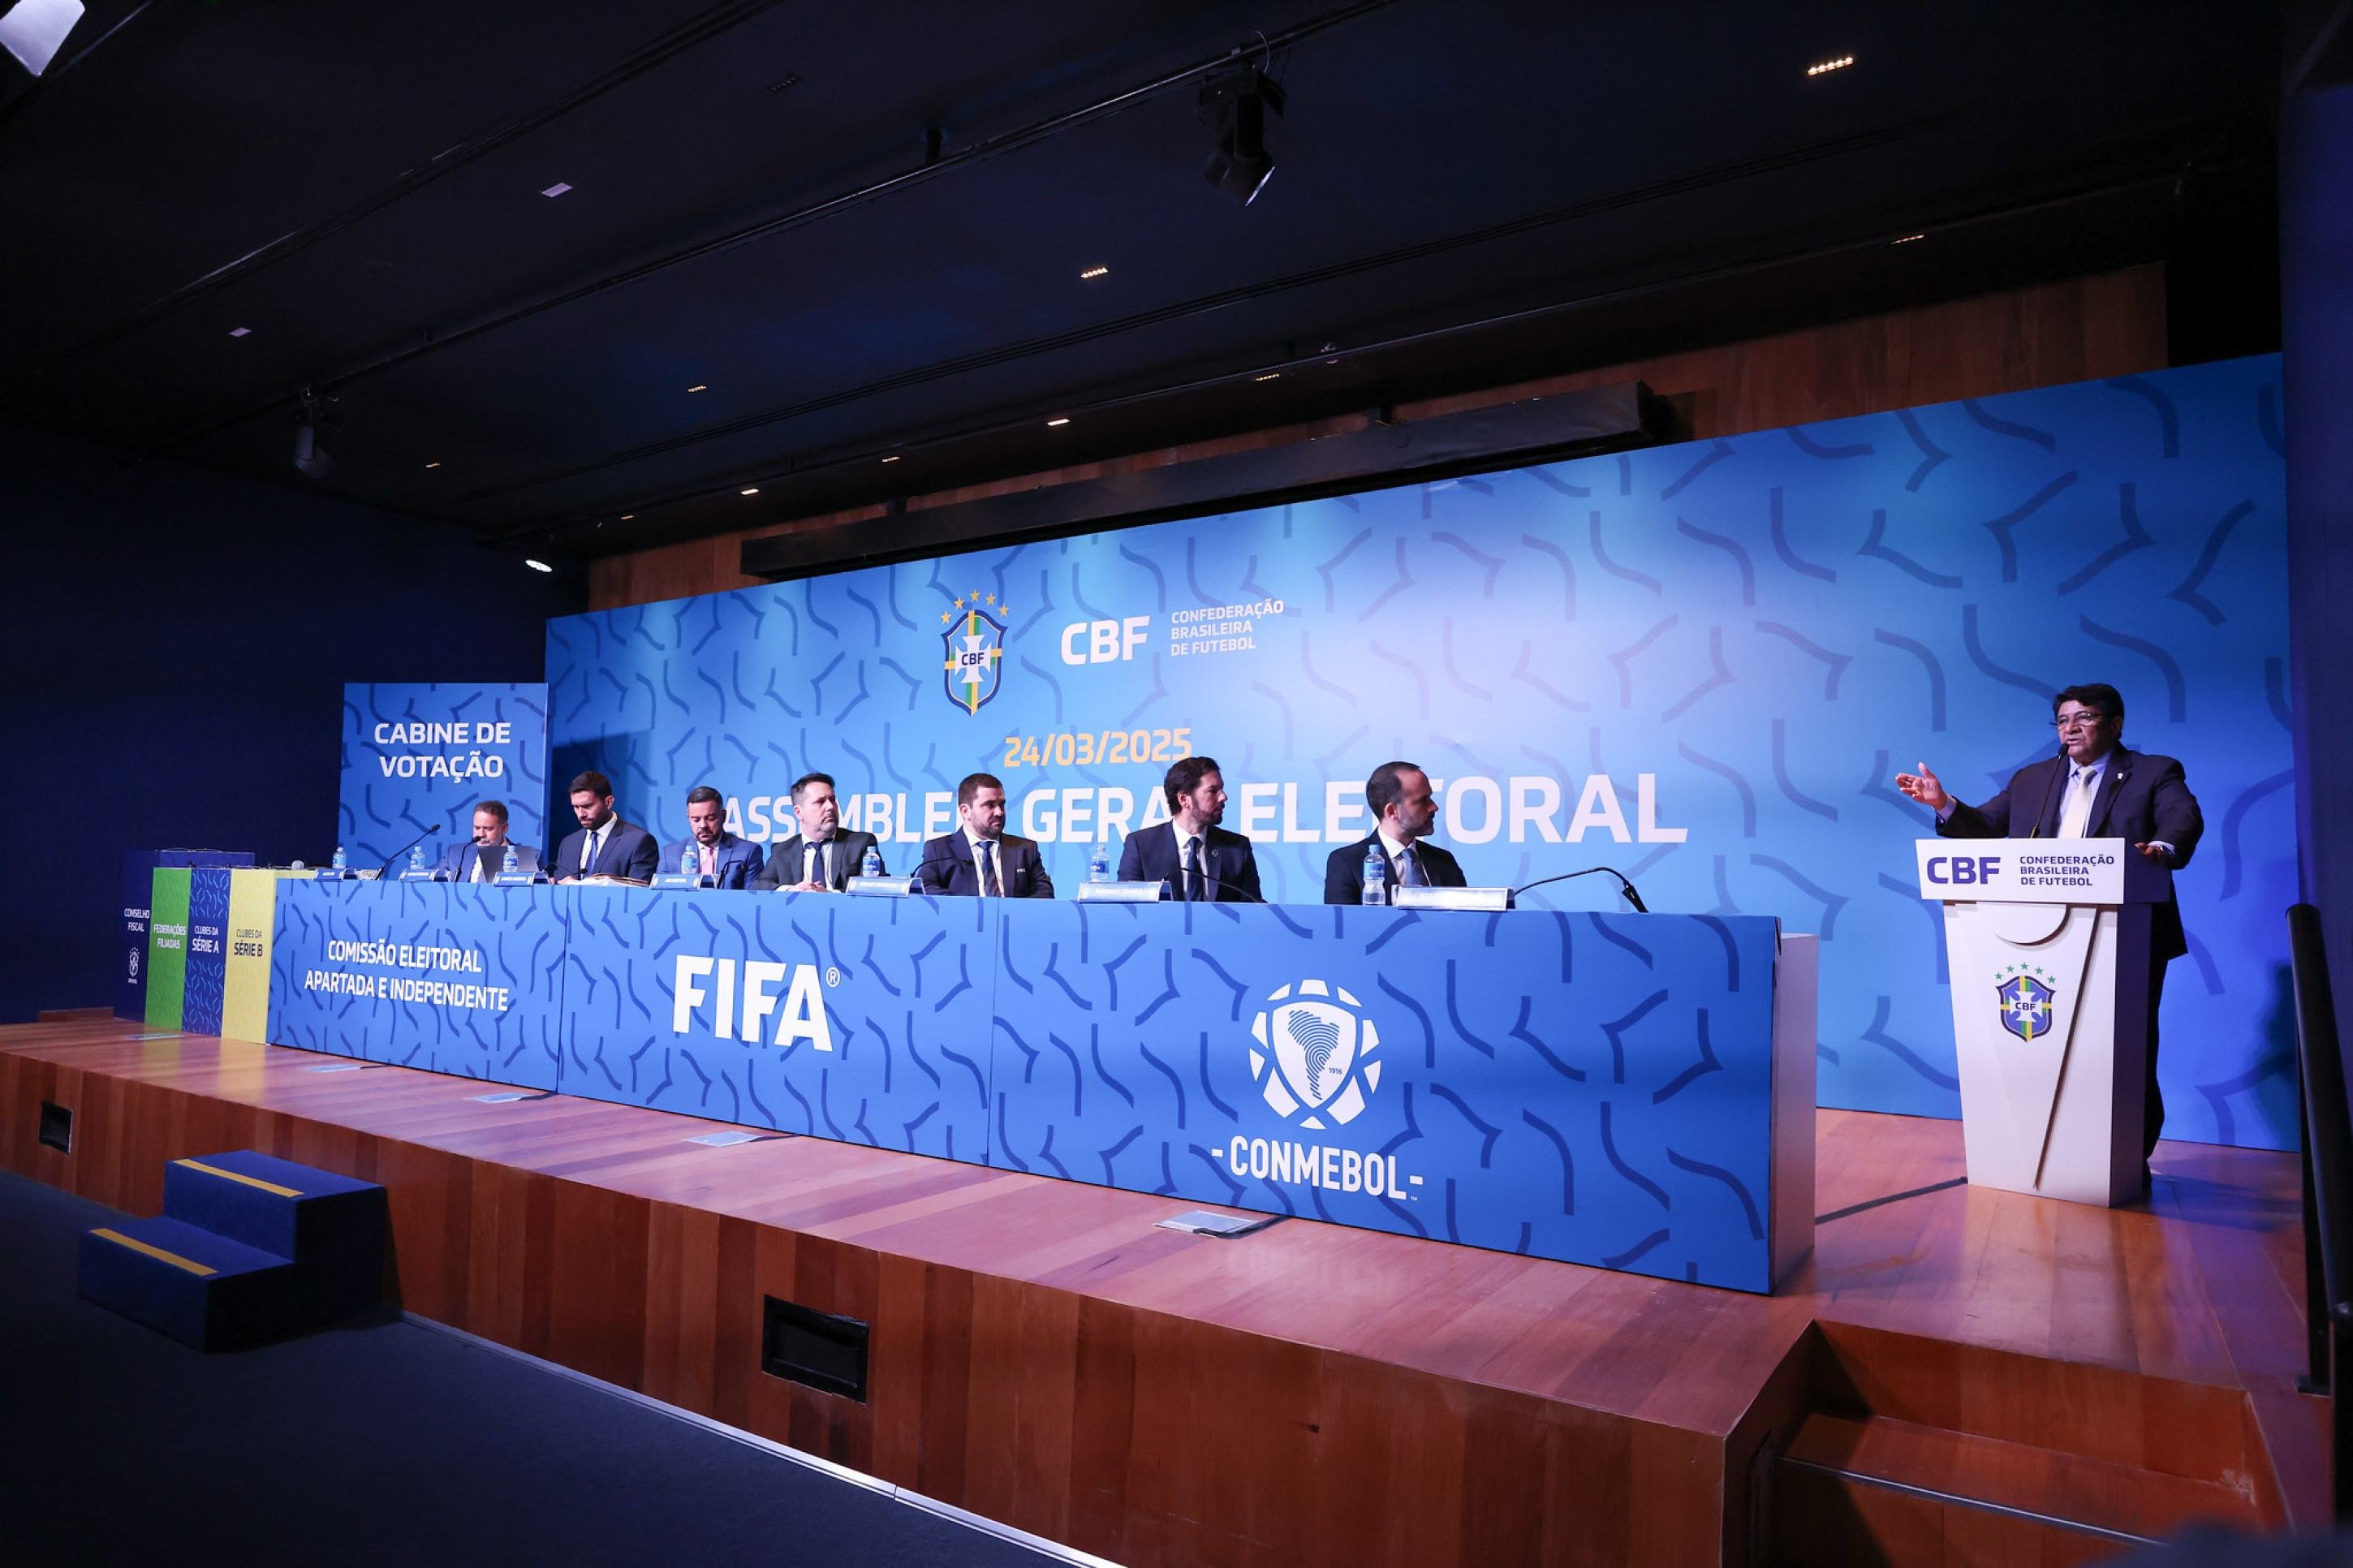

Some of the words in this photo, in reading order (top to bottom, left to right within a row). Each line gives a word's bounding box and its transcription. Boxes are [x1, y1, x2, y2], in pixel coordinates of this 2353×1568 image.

[1171, 598, 1284, 623] CONFEDERAÇÃO
[1171, 620, 1252, 640] BRASILEIRA
[1061, 615, 1151, 666] CBF
[1171, 643, 1188, 657] DE
[1192, 636, 1256, 654] FUTEBOL
[960, 652, 985, 666] CBF
[374, 722, 469, 744] CABINE
[476, 722, 511, 744] DE
[1004, 728, 1192, 768] 24/03/2025
[379, 750, 504, 784] VOTAÇÃO
[722, 791, 963, 843] ASSMBLE
[1022, 786, 1173, 843] GERA
[1240, 773, 1688, 844] ELEORAL
[1927, 856, 2001, 885] CBF
[2019, 855, 2114, 867] CONFEDERAÇÃO
[2020, 867, 2089, 875] BRASILEIRA
[2021, 877, 2036, 885] DE
[2039, 877, 2092, 886] FUTEBOL
[123, 908, 150, 919] CONSELHO
[127, 922, 144, 932] FISCAL
[195, 925, 211, 935] CLUBES
[212, 927, 218, 935] DA
[236, 929, 254, 938] CLUBES
[255, 930, 262, 939] DA
[157, 938, 181, 949] FILIADAS
[192, 936, 213, 953] SÉRIE
[213, 941, 219, 954] A
[234, 940, 256, 956] SÉRIE
[257, 944, 263, 957] B
[328, 938, 396, 966] COMISSÃO
[399, 945, 482, 972] ELEITORAL
[304, 970, 375, 997] APARTADA
[378, 977, 388, 998] E
[390, 978, 510, 1011] INDEPENDENTE
[673, 954, 834, 1052] FIFA
[2015, 1002, 2036, 1010] CBF
[1230, 1135, 1407, 1200] CONMEBOL
